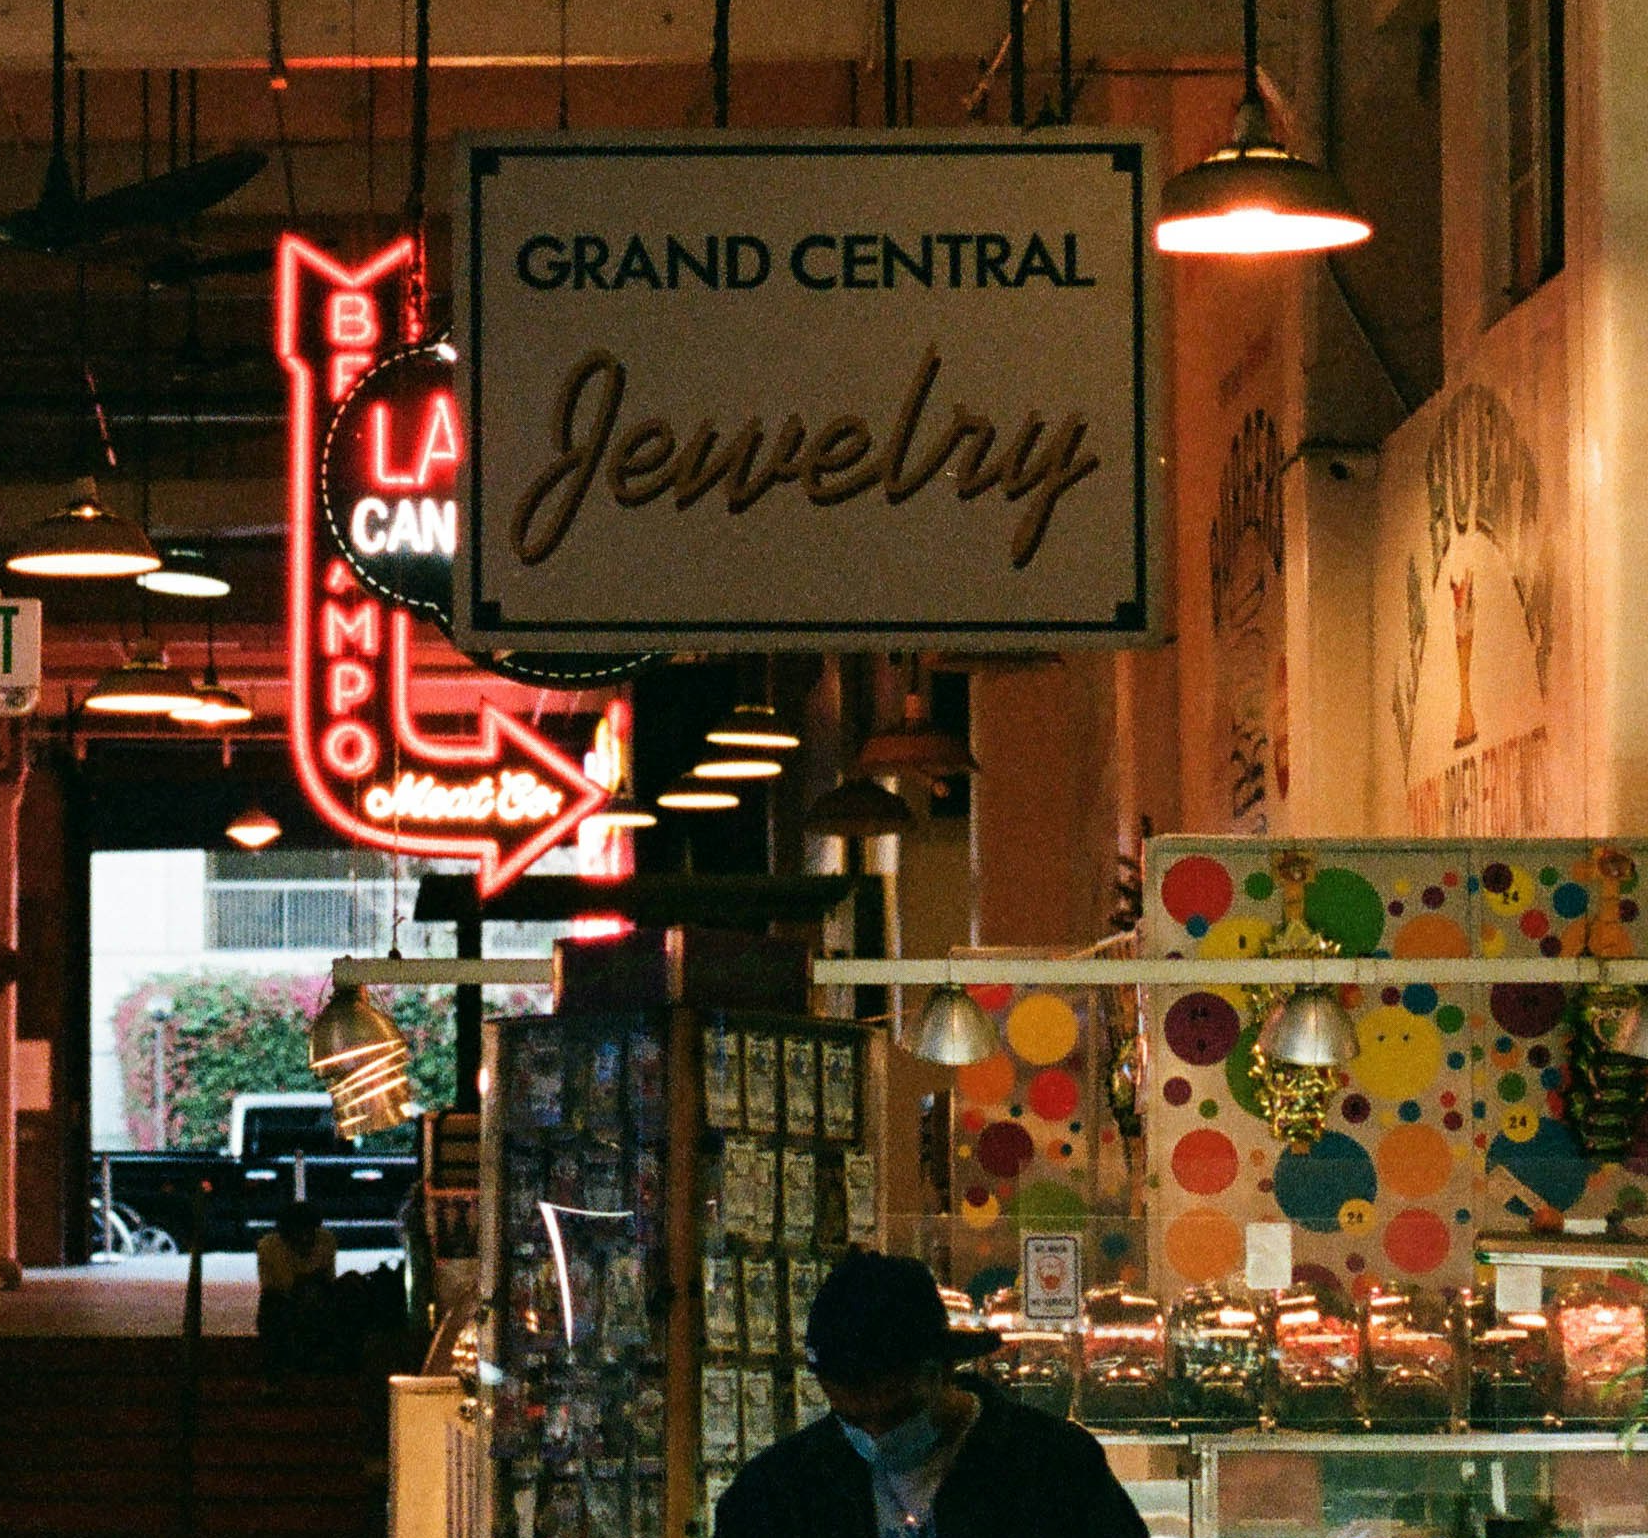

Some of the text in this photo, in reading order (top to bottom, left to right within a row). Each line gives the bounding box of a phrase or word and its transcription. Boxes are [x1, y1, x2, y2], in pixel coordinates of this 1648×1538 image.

[515, 232, 1097, 294] GRAND CENTRAL
[507, 342, 1102, 572] Jewelry
